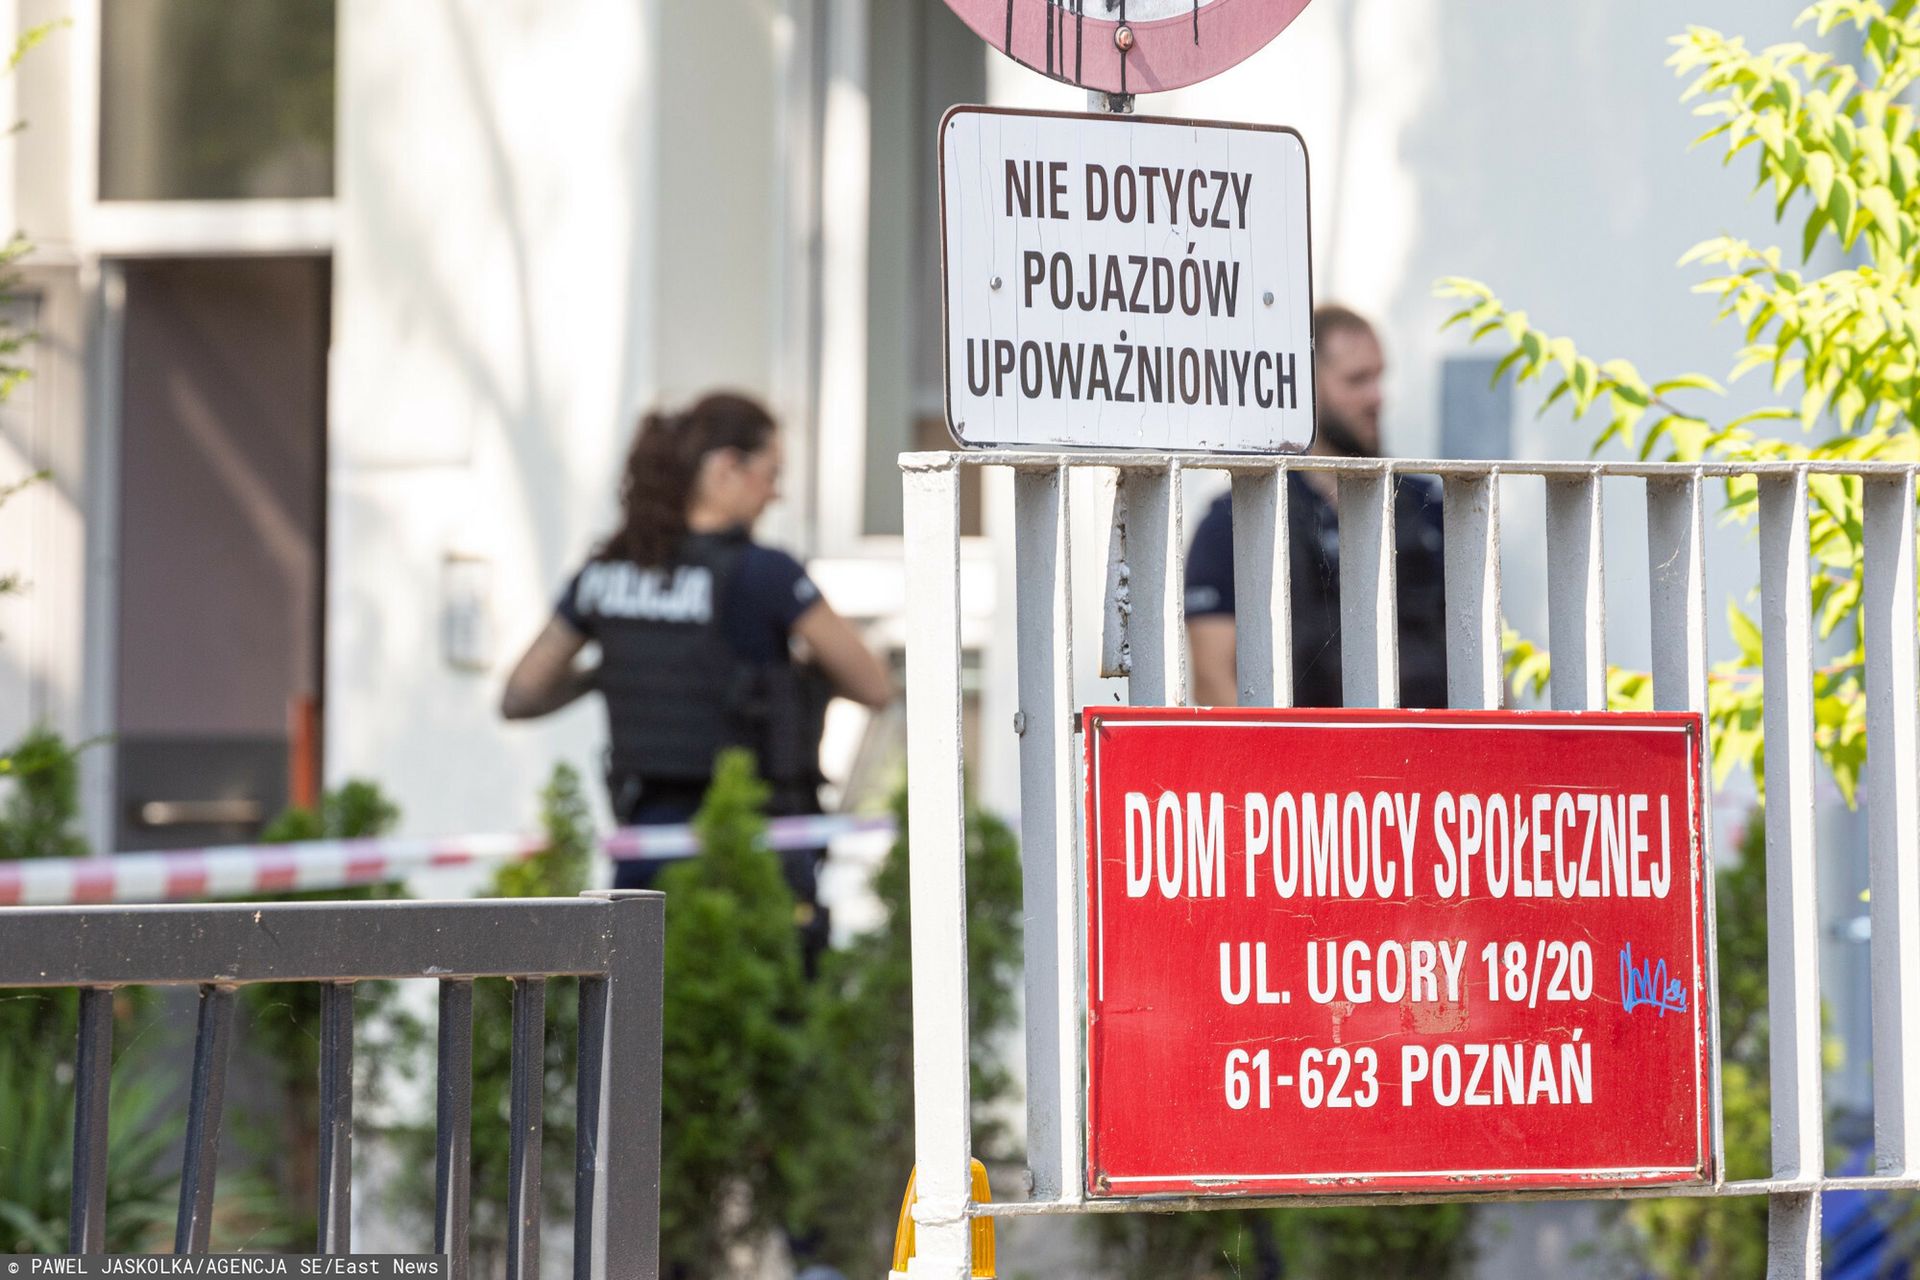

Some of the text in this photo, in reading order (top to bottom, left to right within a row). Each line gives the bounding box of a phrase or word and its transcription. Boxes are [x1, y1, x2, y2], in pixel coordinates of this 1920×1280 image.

[1005, 159, 1253, 230] NIE DOTYCZY
[1023, 241, 1240, 318] POJAZDÓW
[966, 329, 1298, 410] UPOWAŻNIONYCH
[1124, 790, 1672, 900] DOM POMOCY SPOŁECZNEJ
[1219, 941, 1291, 1005] UL.
[1306, 939, 1468, 1004] UGORY
[1481, 939, 1594, 1009] 18/20
[1224, 1027, 1594, 1110] 61-623 POZNAŃ
